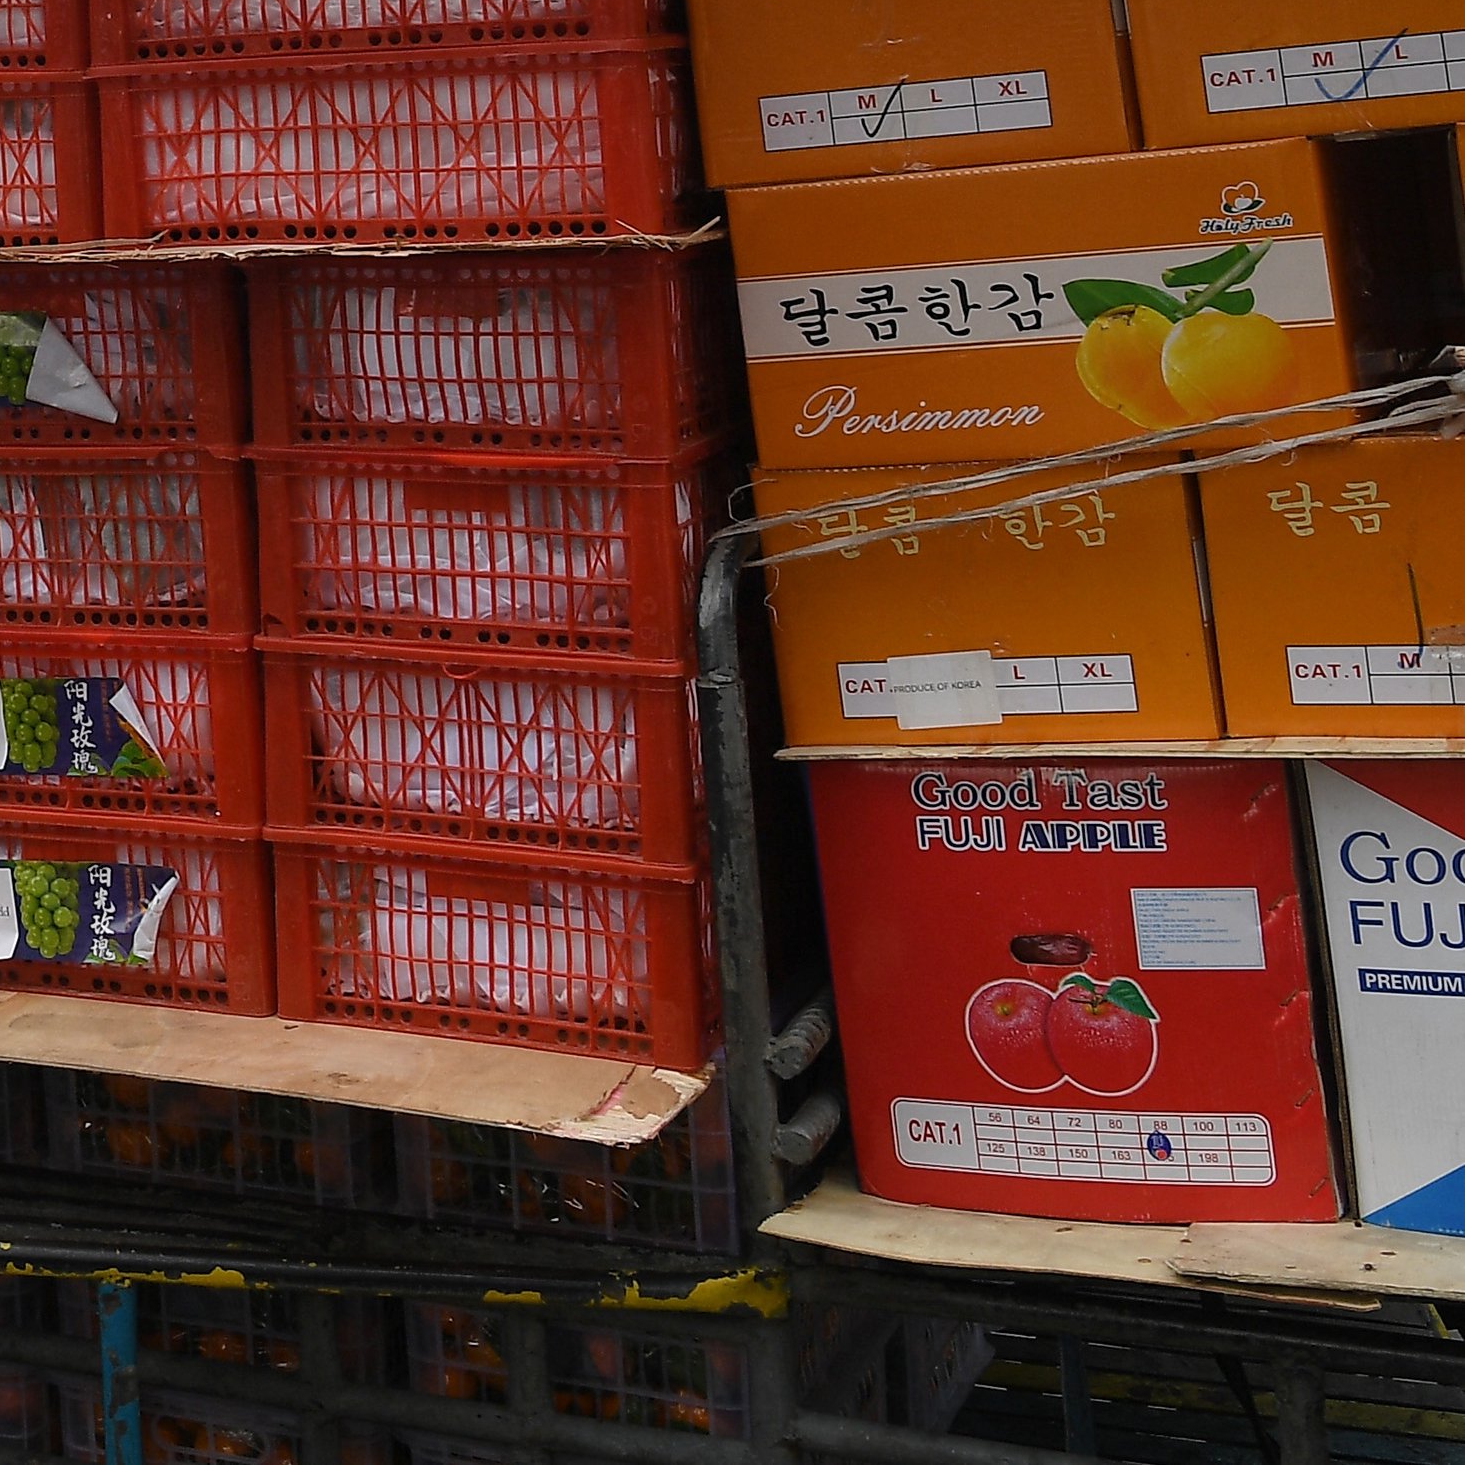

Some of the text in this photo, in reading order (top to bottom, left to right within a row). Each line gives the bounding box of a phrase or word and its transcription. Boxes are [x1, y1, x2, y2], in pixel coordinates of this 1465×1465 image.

[1209, 44, 1409, 87] CAT.1 M L
[767, 80, 1027, 128] CAT.1 M L XL
[779, 272, 1055, 347] 달콤한감
[794, 384, 1046, 438] Persimmon
[1266, 481, 1391, 536] 달콤
[1013, 665, 1025, 680] L
[1082, 662, 1112, 678] XL
[1295, 653, 1420, 679] CAT.1 M
[894, 681, 981, 693] PRODUCE OF KOREA
[64, 680, 96, 774] 阳光玫瑰
[912, 769, 1168, 810] Good Tast
[917, 816, 1168, 852] FUJI APPLE
[88, 864, 117, 962] 阳光玫瑰
[1365, 973, 1462, 992] PREMIUM
[909, 1112, 1256, 1145] CAT.1 56 64 72 80 88 100 113
[987, 1143, 1218, 1164] 125 138 150 163 198
